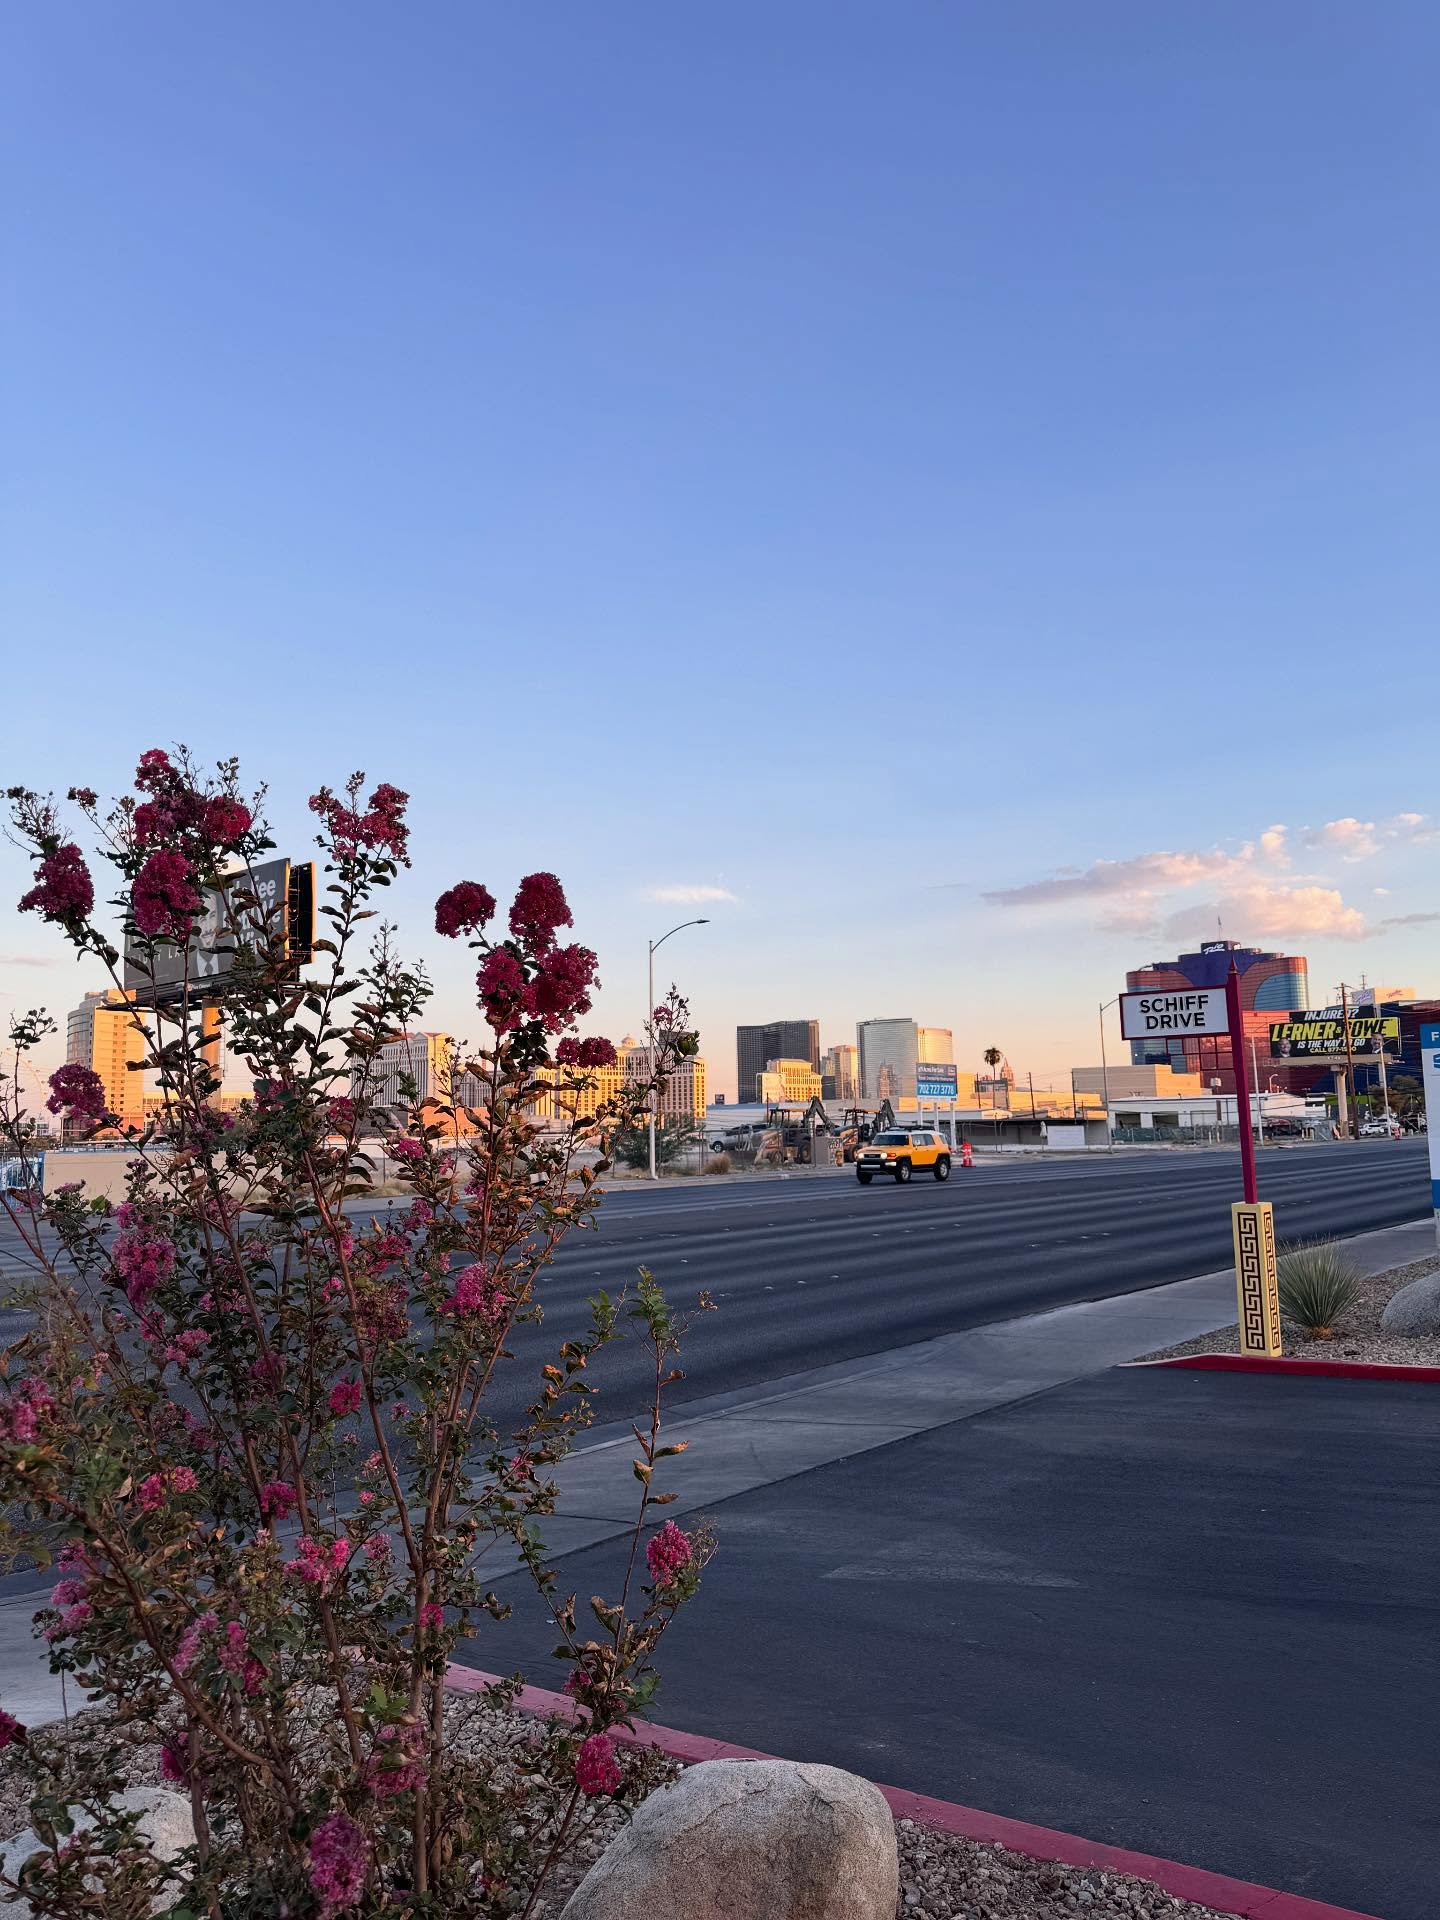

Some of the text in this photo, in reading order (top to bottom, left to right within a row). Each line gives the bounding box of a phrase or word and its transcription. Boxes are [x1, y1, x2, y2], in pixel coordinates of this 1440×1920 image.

[1140, 994, 1208, 1014] SCHIFF
[1146, 1012, 1206, 1030] DRIVE
[1271, 1021, 1337, 1042] LERNER
[1297, 1041, 1306, 1049] IS
[1308, 1040, 1323, 1049] THE
[1324, 1039, 1341, 1048] WAY
[1354, 1038, 1366, 1046] GO
[918, 1084, 930, 1094] 702
[930, 1084, 940, 1094] 727
